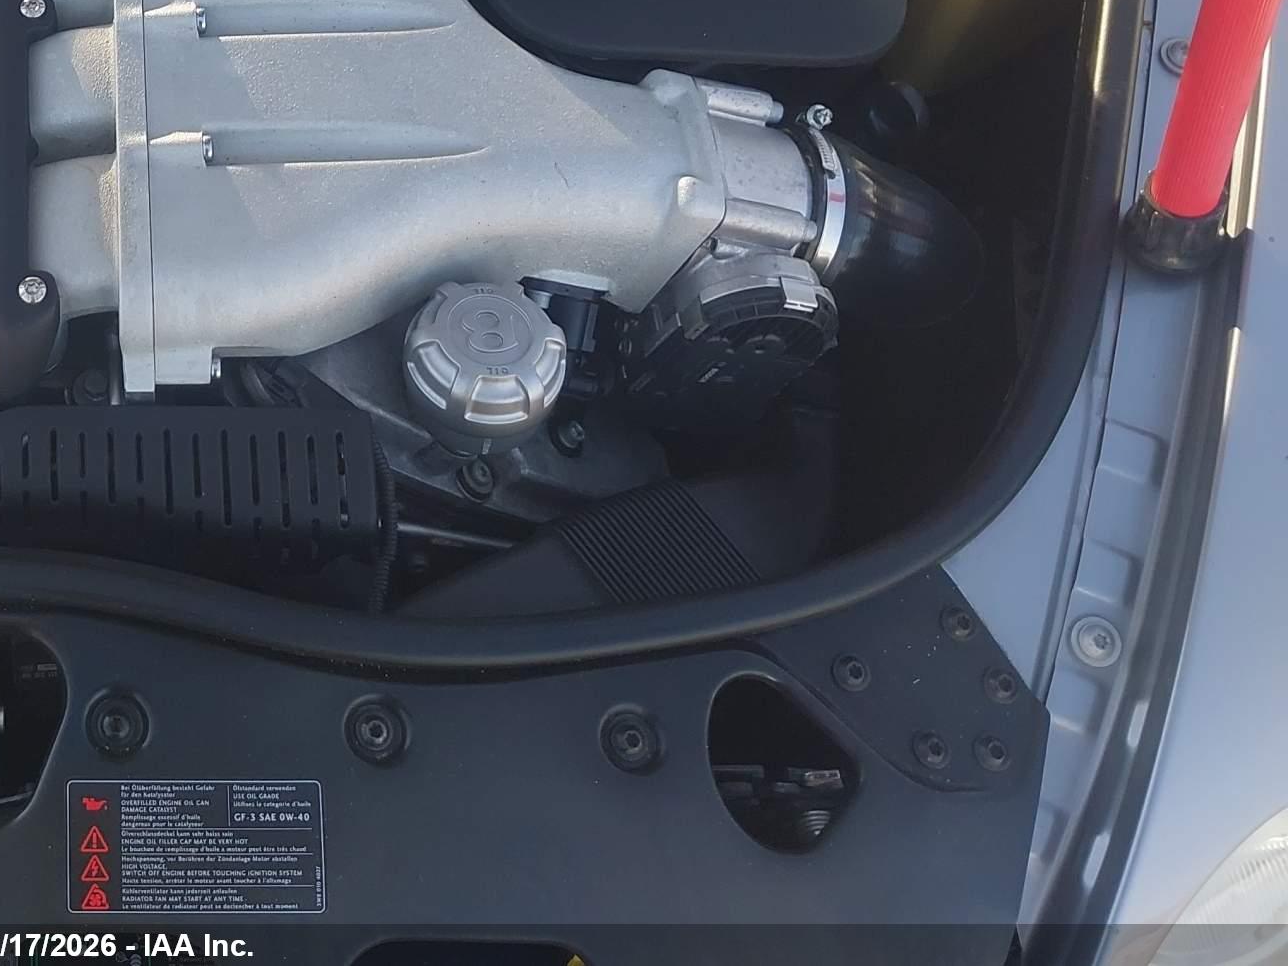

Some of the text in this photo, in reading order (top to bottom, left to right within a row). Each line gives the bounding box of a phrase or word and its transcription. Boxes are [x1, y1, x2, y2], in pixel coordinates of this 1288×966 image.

[234, 813, 310, 822] GF-3 SAE 0W-40
